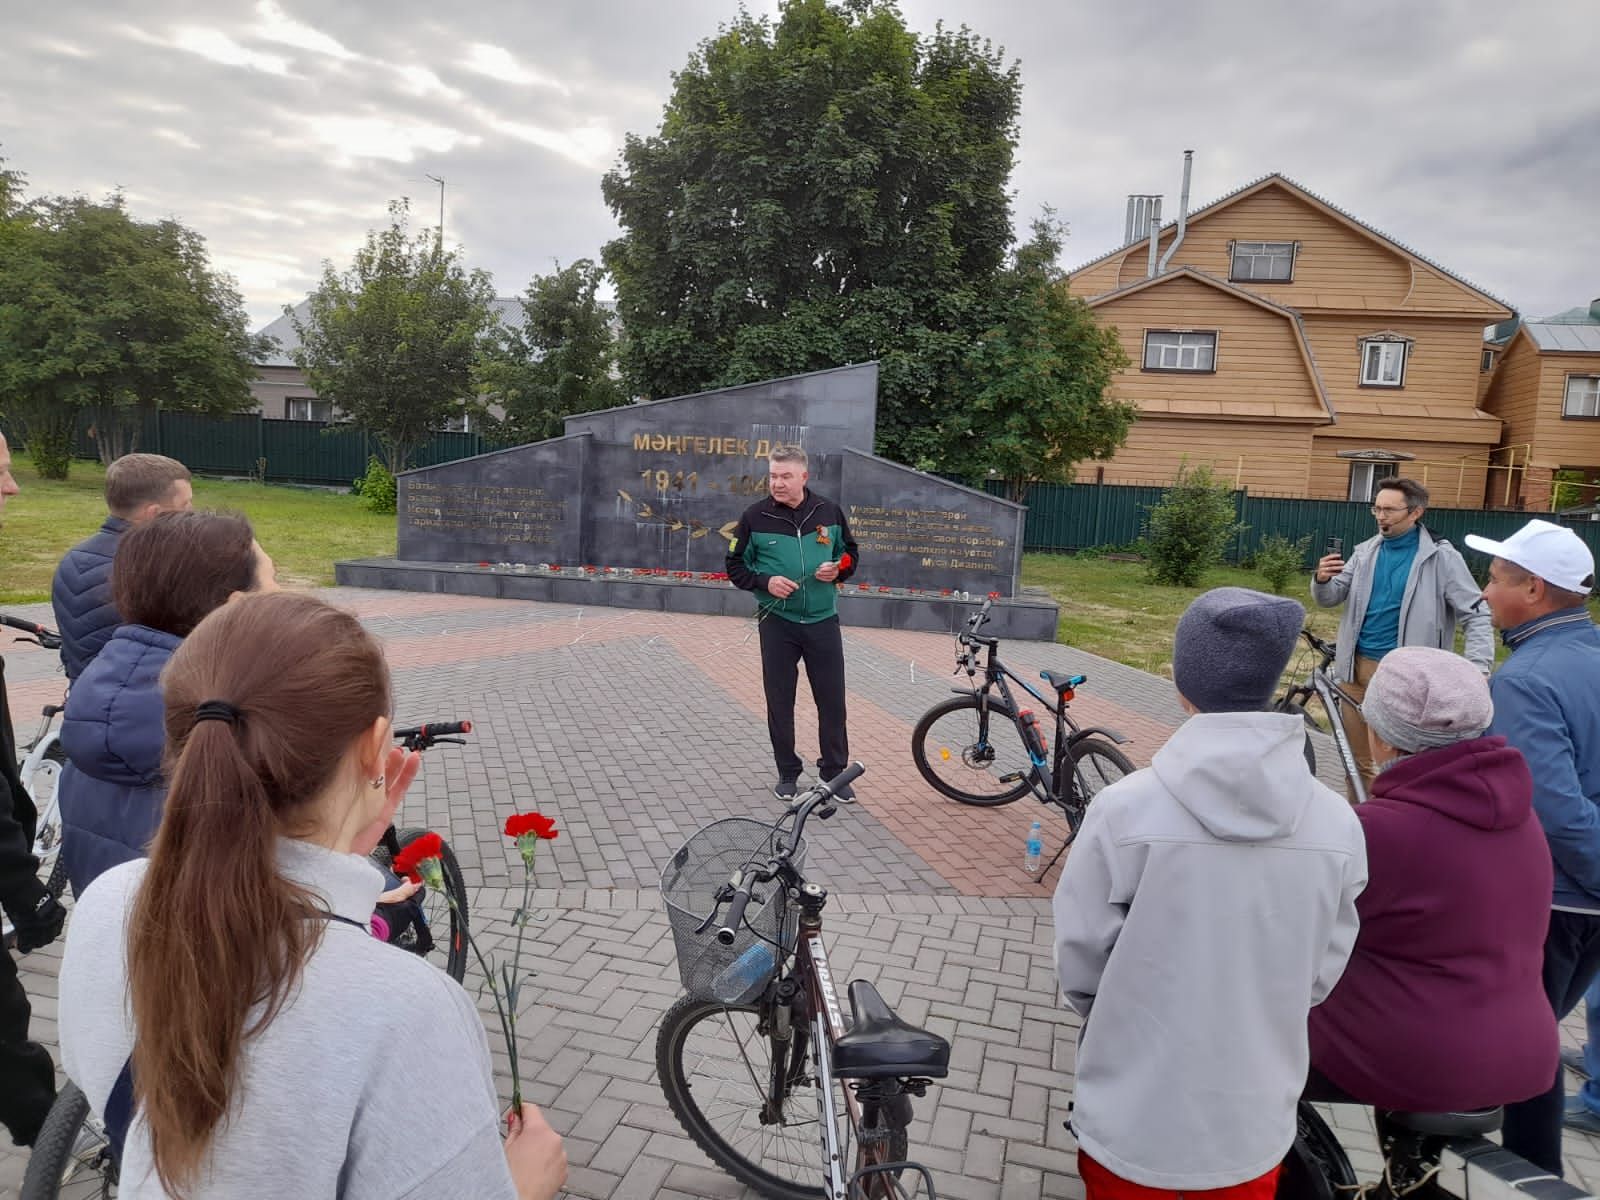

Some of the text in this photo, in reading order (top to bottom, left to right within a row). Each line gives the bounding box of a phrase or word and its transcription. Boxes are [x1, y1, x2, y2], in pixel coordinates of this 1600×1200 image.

[633, 433, 749, 455] МӘҢГЕЛЕК
[641, 469, 698, 491] 1941
[728, 474, 769, 496] 194
